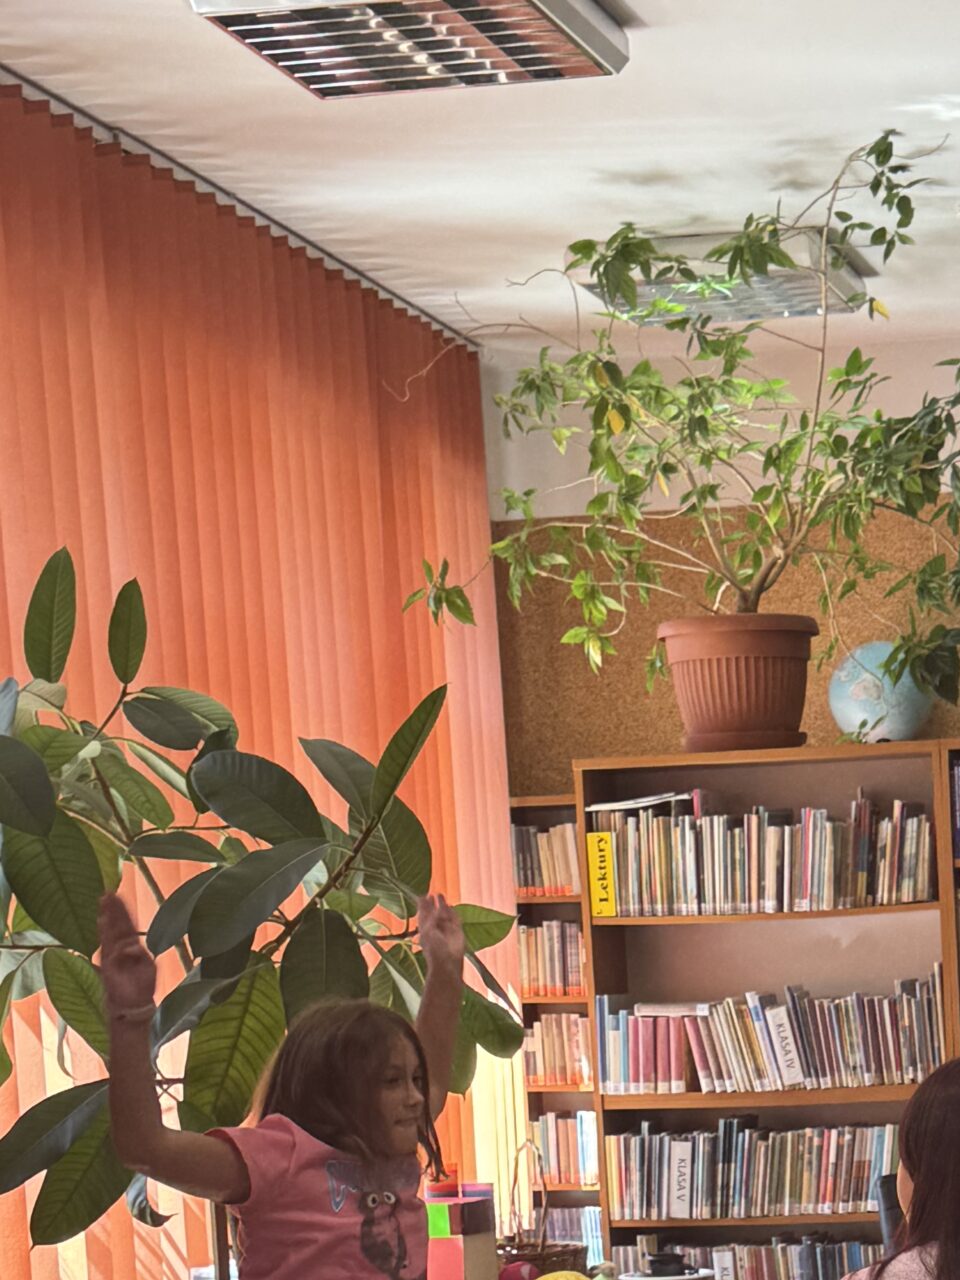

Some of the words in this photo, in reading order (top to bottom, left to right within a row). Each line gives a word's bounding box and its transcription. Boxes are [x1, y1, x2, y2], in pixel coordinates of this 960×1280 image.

[596, 835, 609, 903] Lektury
[775, 1022, 793, 1057] KLASA
[676, 1158, 687, 1192] KLASA
[676, 1194, 686, 1202] V
